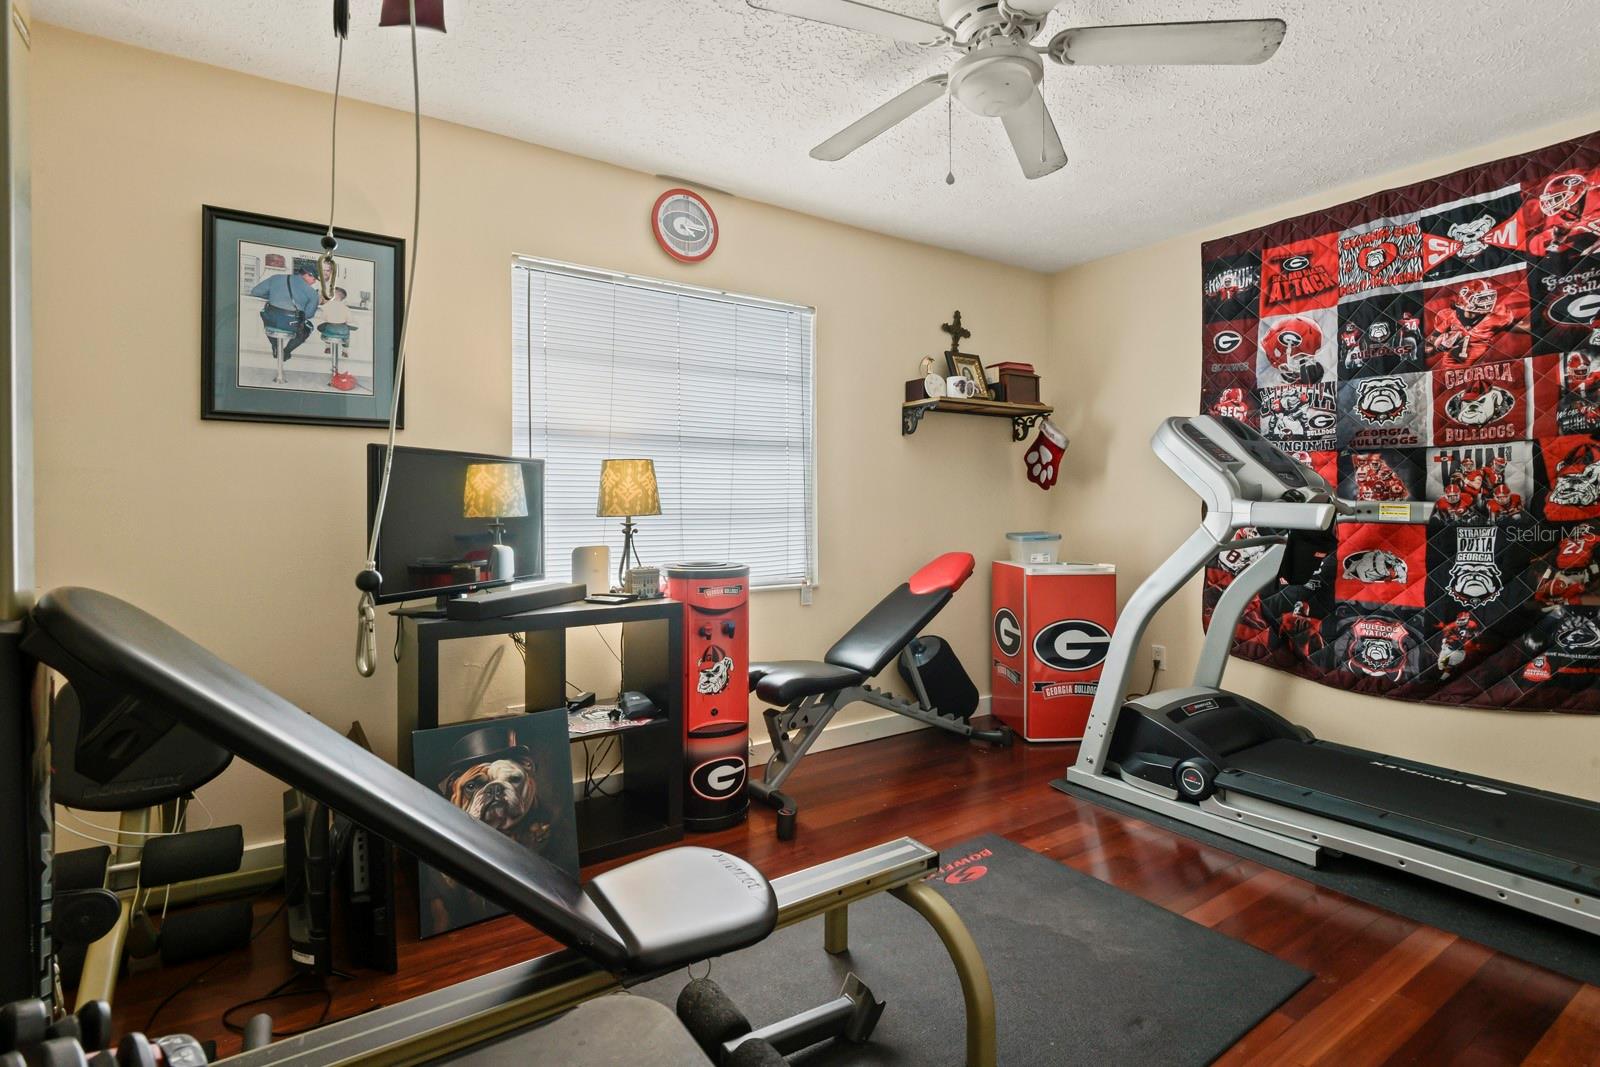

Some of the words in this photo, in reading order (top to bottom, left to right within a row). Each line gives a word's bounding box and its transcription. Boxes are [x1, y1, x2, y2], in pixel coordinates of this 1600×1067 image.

[1269, 272, 1335, 304] ATTACK
[1445, 363, 1513, 390] GEORGIA
[1306, 427, 1336, 437] BULLDOGS
[1355, 427, 1410, 437] GEORGIA
[1445, 424, 1515, 442] BULLDOGS
[1320, 439, 1337, 451] IT
[1348, 435, 1418, 448] BULLDOGS
[1458, 528, 1496, 538] STRAIGHT
[1460, 537, 1493, 552] OUTTA
[1457, 553, 1492, 562] GEORGIA
[1360, 623, 1400, 633] BULLDOG
[1365, 630, 1393, 639] NATION
[1045, 685, 1073, 697] GEORGIA
[1074, 684, 1097, 694] BULLDOG
